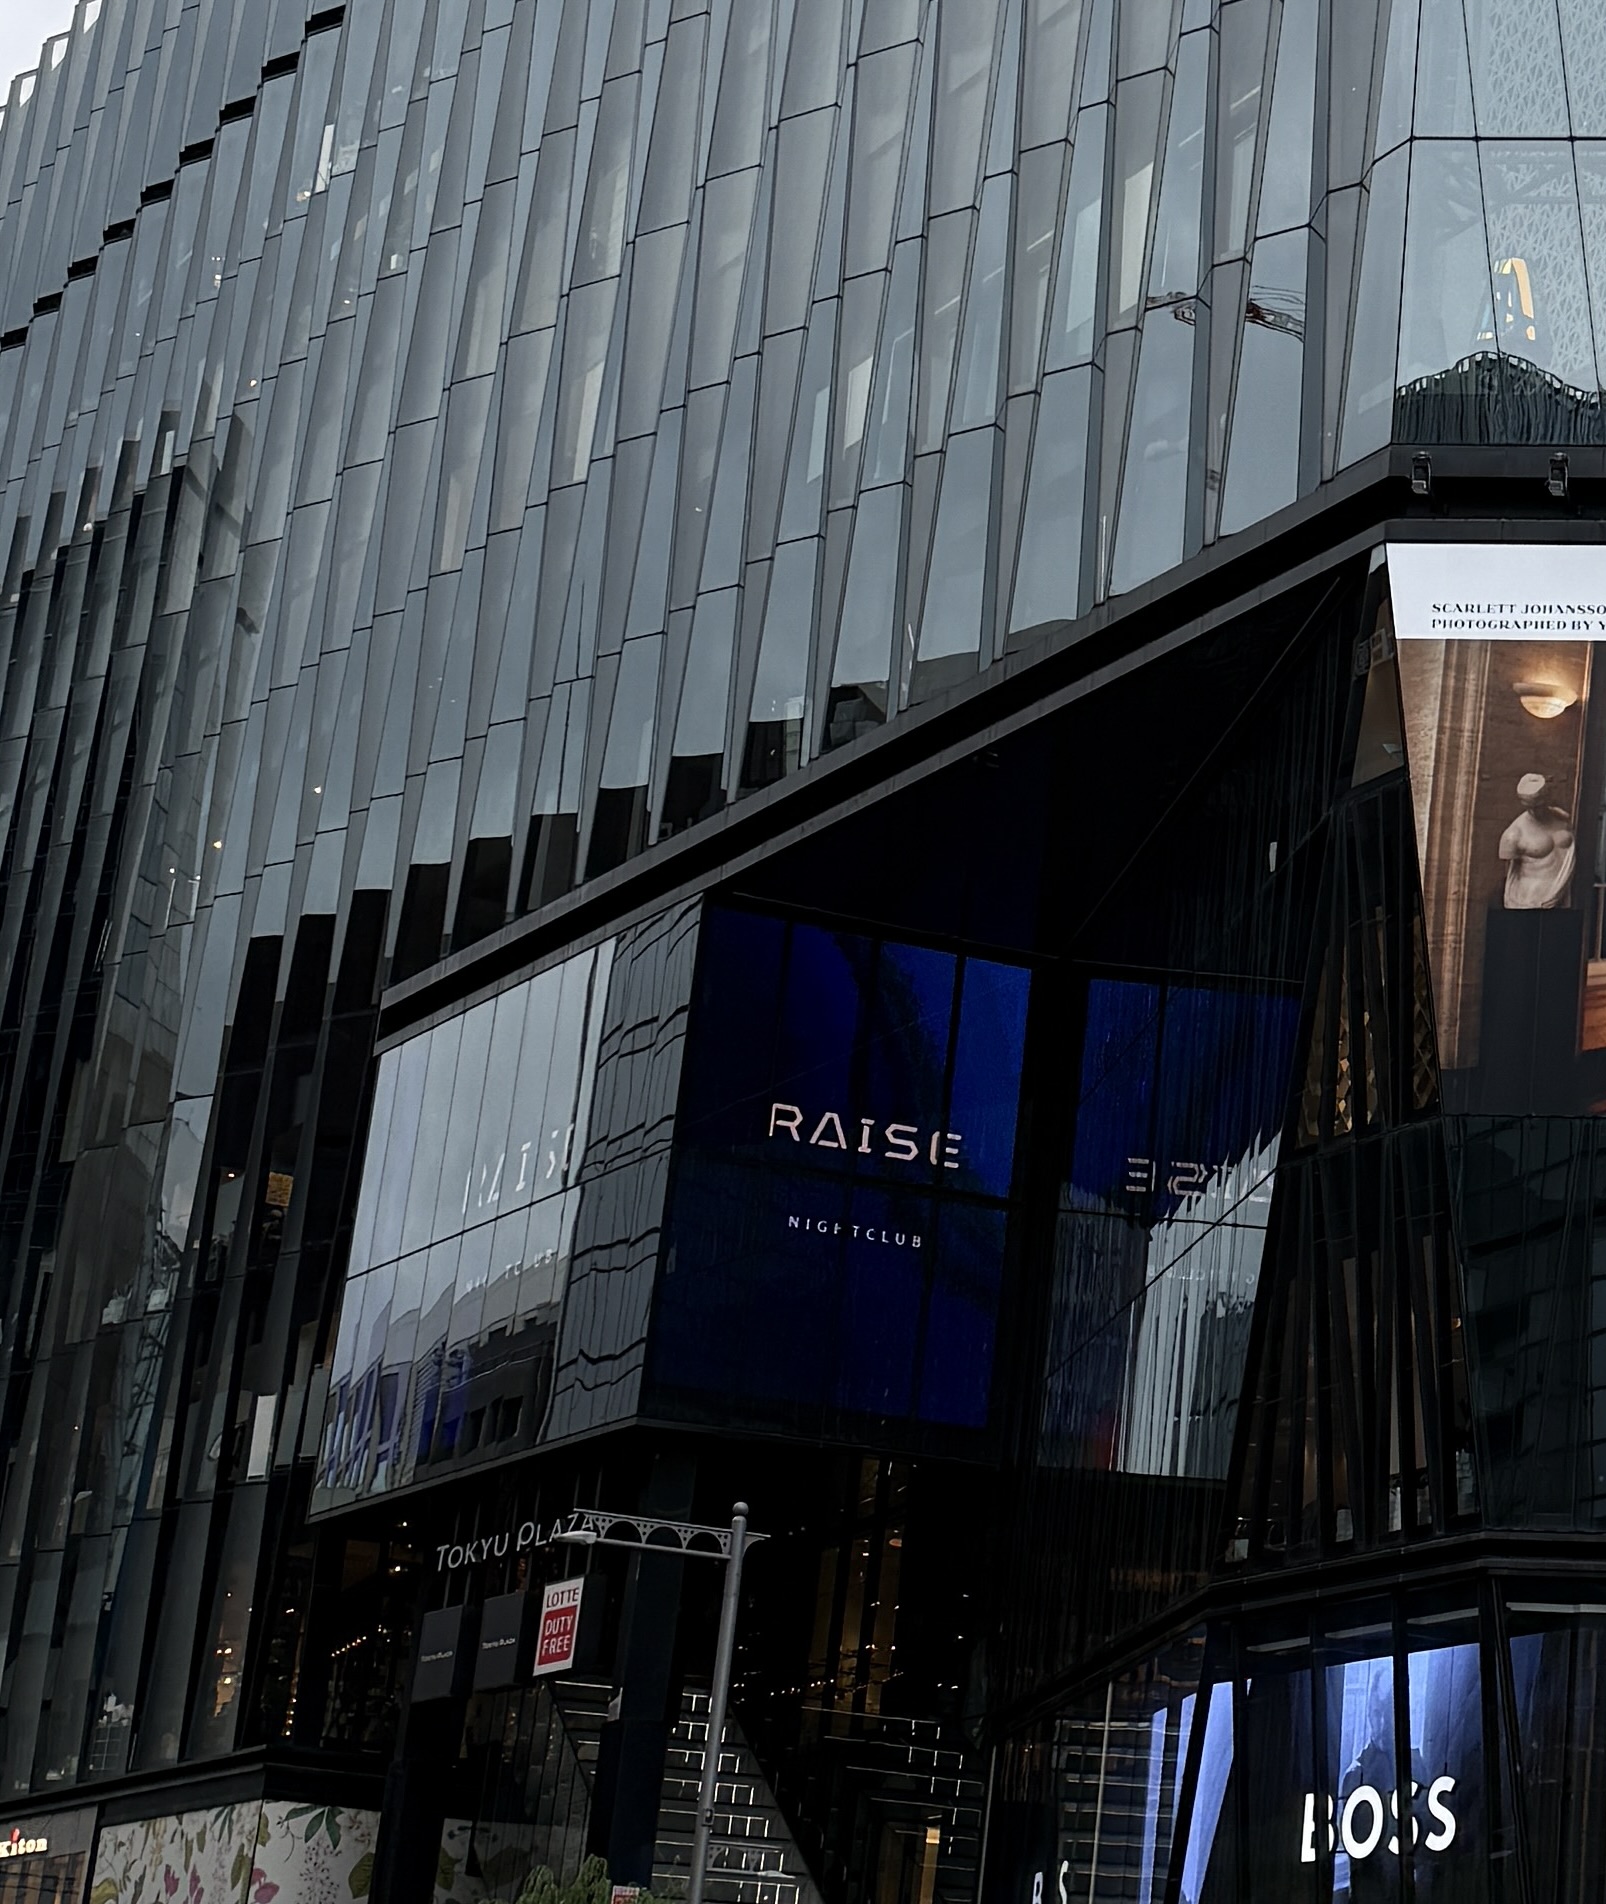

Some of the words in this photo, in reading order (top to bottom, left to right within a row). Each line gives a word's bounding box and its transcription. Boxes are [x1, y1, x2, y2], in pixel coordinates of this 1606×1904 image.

[1431, 602, 1517, 614] SCARLETT
[1431, 618, 1567, 630] PHOTOGRAPHED
[1571, 619, 1592, 630] BY
[768, 1101, 963, 1170] RAISE
[787, 1214, 923, 1249] NIGHTCLUB
[436, 1532, 510, 1572] TOKYU
[516, 1512, 595, 1552] PLAZA
[546, 1586, 580, 1608] LOTTE
[544, 1614, 574, 1636] DUTY
[541, 1635, 571, 1657] FREE
[1300, 1775, 1457, 1864] BOSS
[0, 1827, 48, 1858] Kiton
